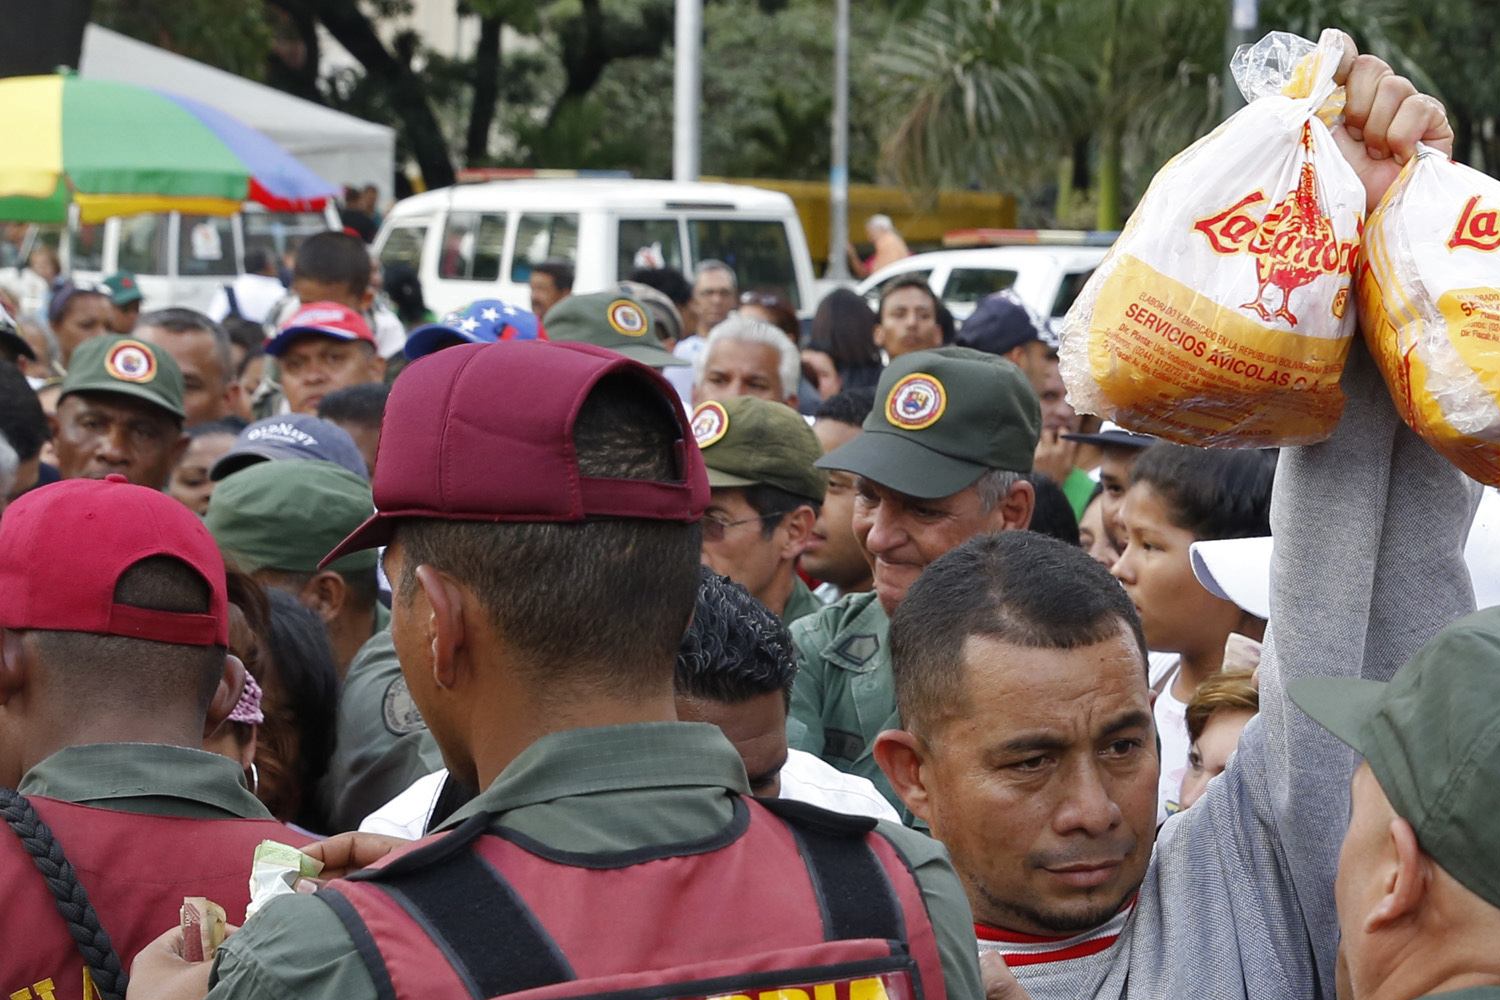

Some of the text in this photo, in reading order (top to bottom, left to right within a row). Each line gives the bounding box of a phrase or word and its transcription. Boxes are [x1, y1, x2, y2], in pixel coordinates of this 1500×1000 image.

[1195, 192, 1264, 253] La
[1125, 302, 1207, 358] SERVICIOS
[1205, 347, 1292, 387] AVICOLAS
[1180, 315, 1218, 340] EMPACADO
[1216, 334, 1229, 346] EN
[1227, 339, 1238, 350] LA
